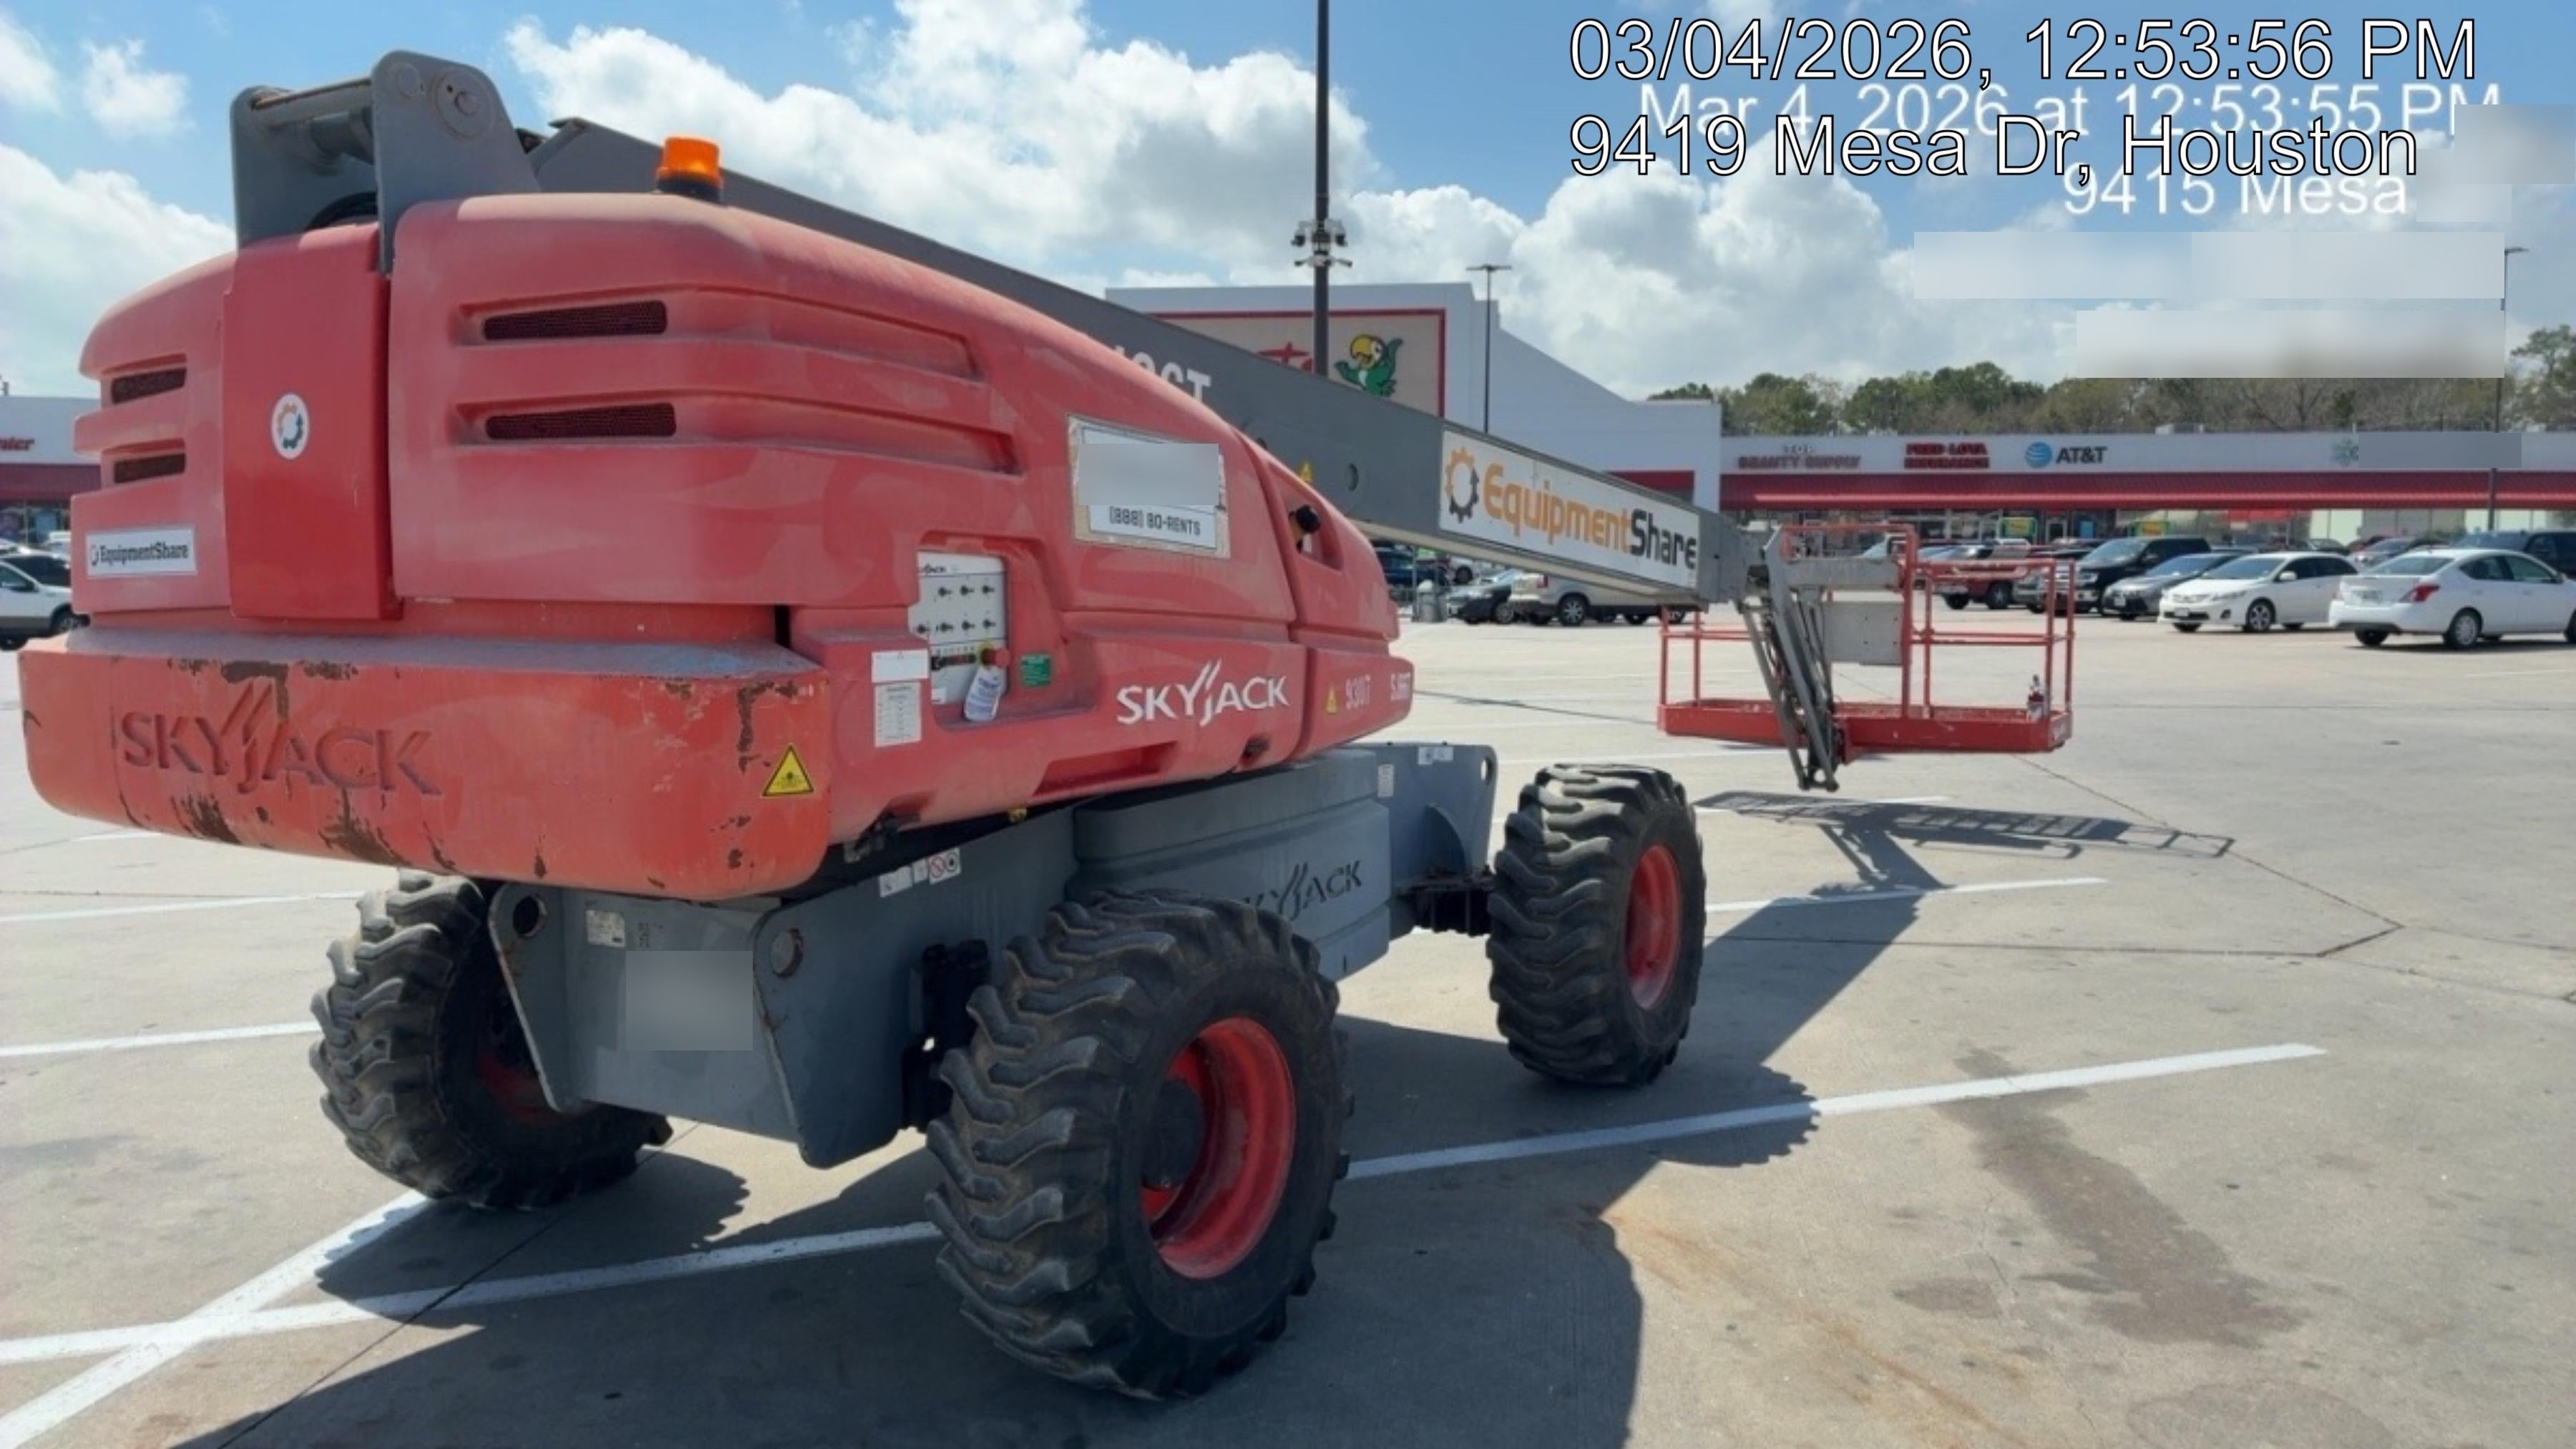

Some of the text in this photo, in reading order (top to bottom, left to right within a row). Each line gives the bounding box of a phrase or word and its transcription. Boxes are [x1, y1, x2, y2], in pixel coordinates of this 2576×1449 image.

[2056, 446, 2108, 464] AT&T
[1109, 505, 1144, 529] (888)
[1483, 463, 1697, 570] EquipmentShare
[99, 541, 189, 566] EquipmentShare
[1116, 657, 1289, 728] SKYJACK
[121, 681, 443, 796] SKYJACK
